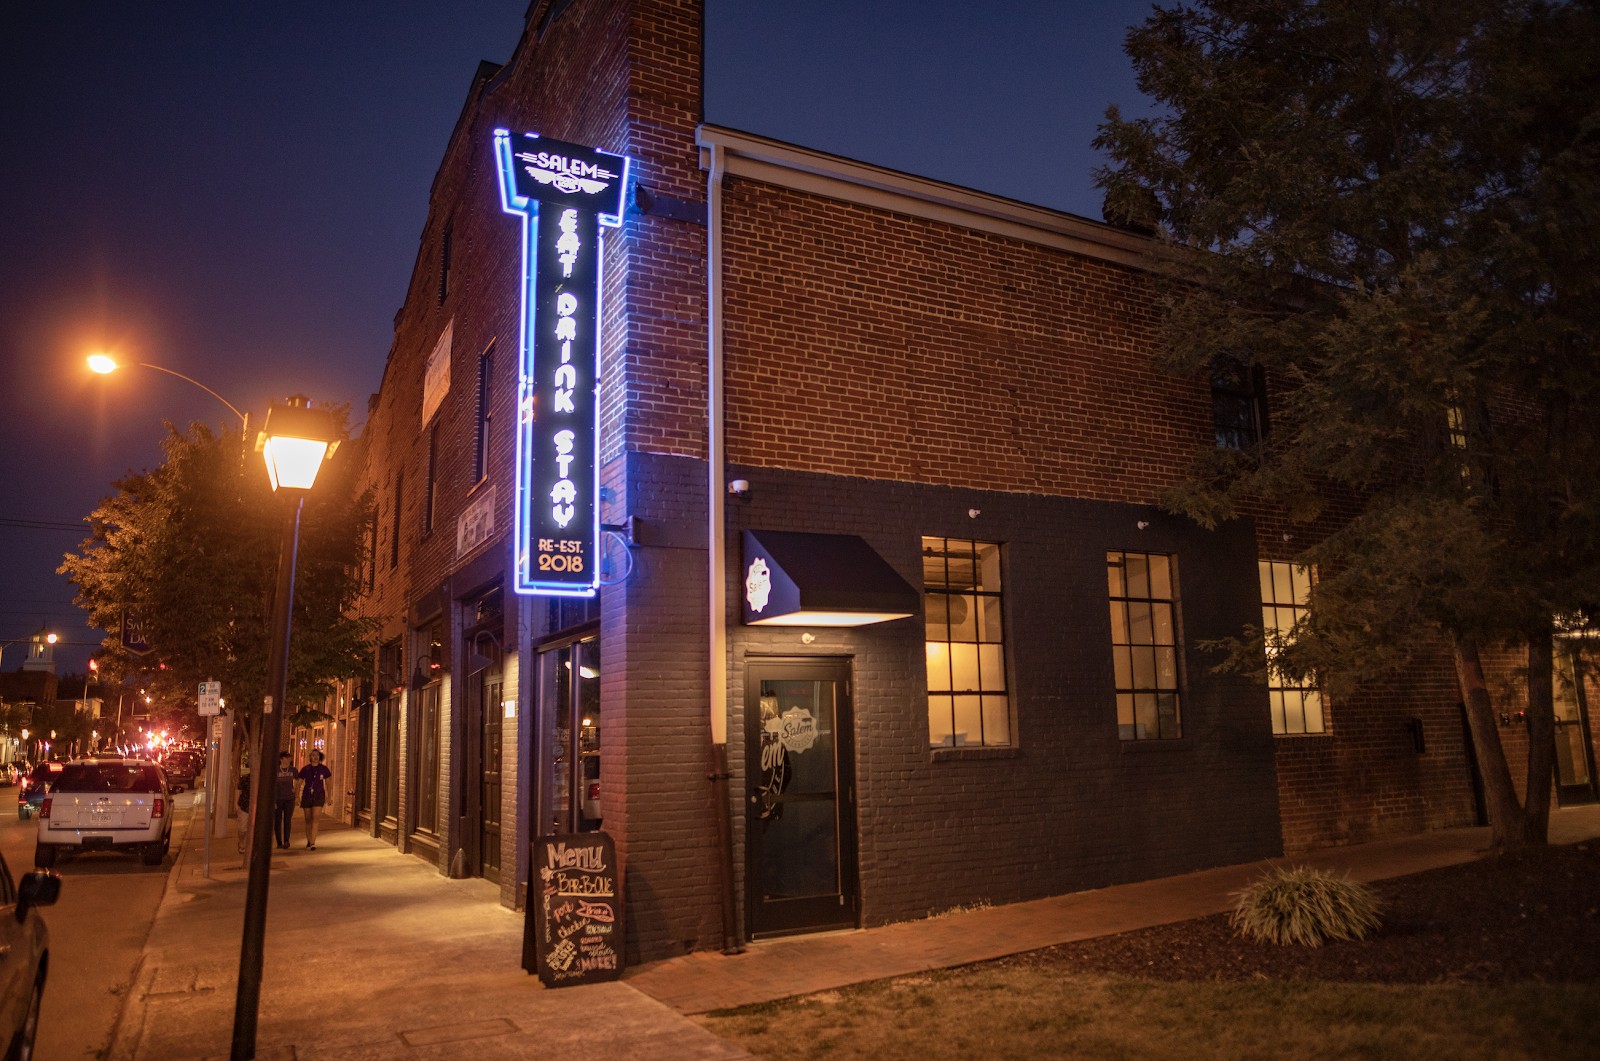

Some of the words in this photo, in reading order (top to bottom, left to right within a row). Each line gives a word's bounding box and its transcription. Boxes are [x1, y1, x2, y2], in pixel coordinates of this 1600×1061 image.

[536, 152, 598, 179] SALEM
[555, 208, 581, 278] EAT
[550, 430, 577, 528] STAY
[538, 538, 584, 554] RE-EST.
[538, 554, 584, 573] 2018
[200, 685, 206, 695] 2
[782, 722, 814, 740] Salem
[546, 842, 603, 869] Menu
